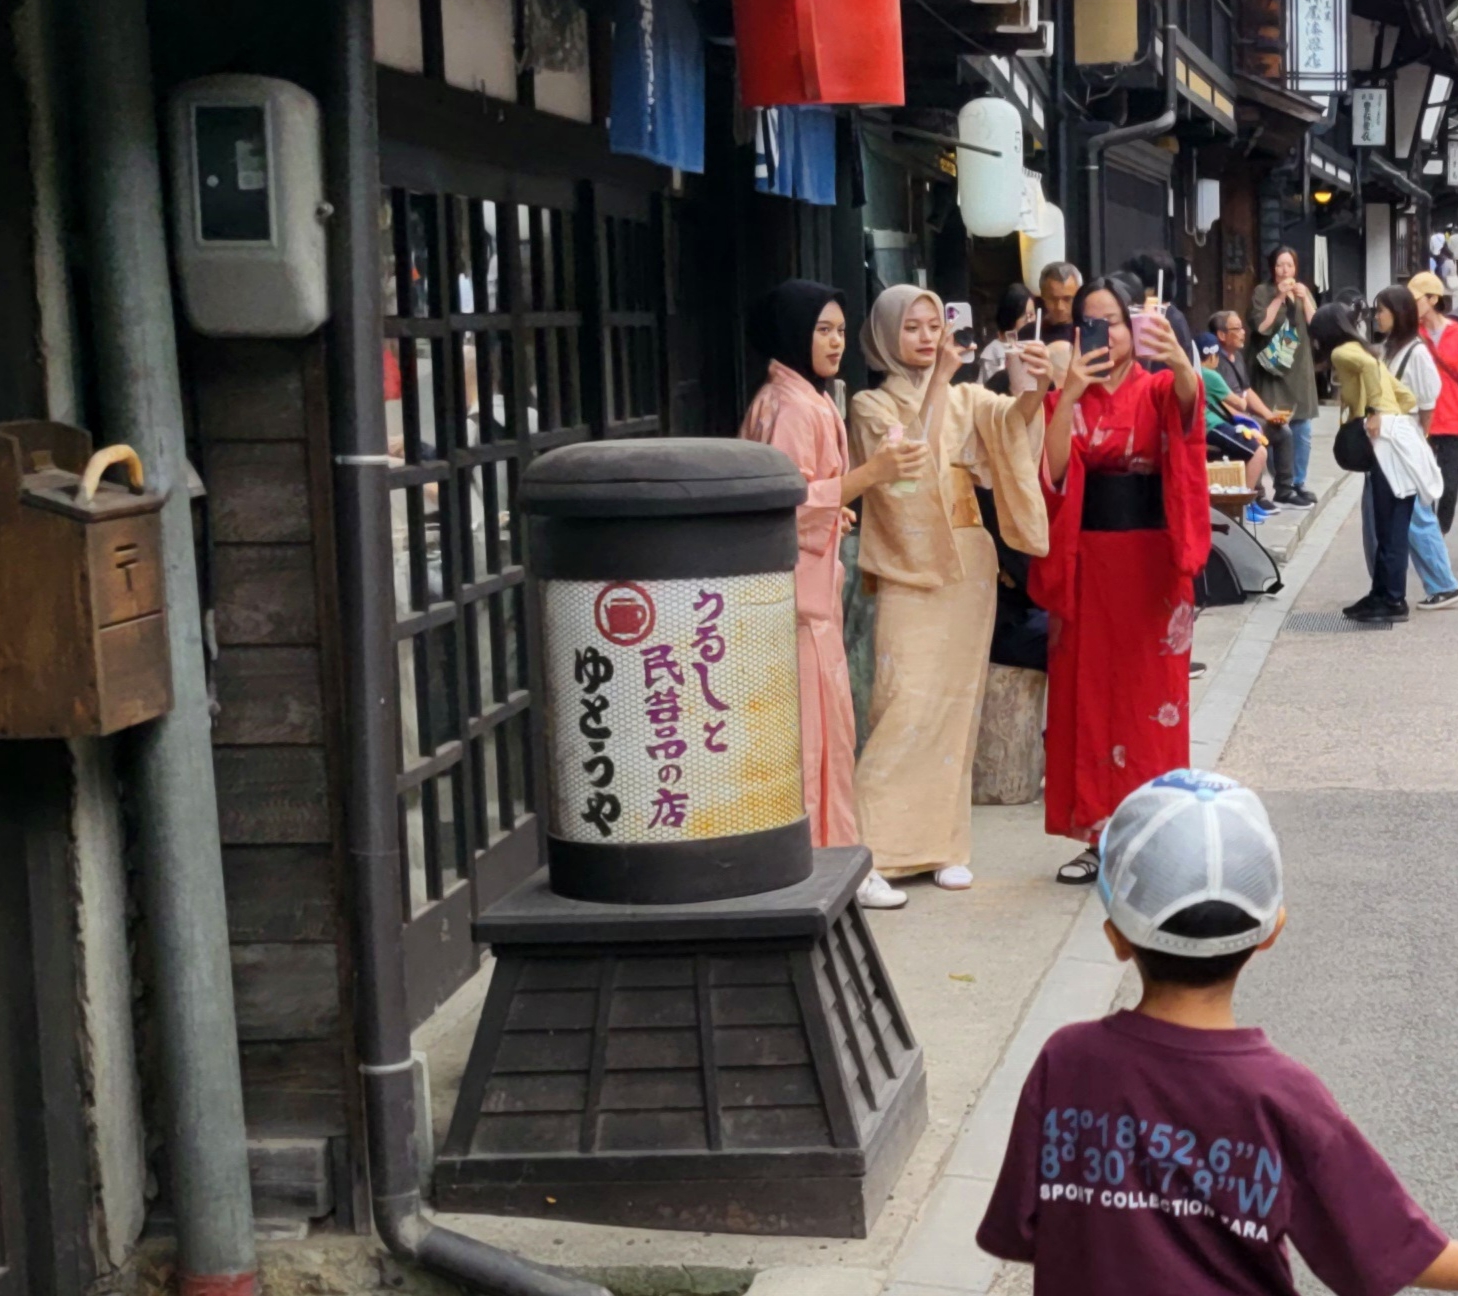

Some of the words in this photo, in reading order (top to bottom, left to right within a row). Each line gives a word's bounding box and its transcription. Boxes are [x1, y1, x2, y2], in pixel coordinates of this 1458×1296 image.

[574, 646, 621, 838] ゆとうや
[639, 644, 689, 830] 民芸品の店
[690, 589, 731, 753] うるしと
